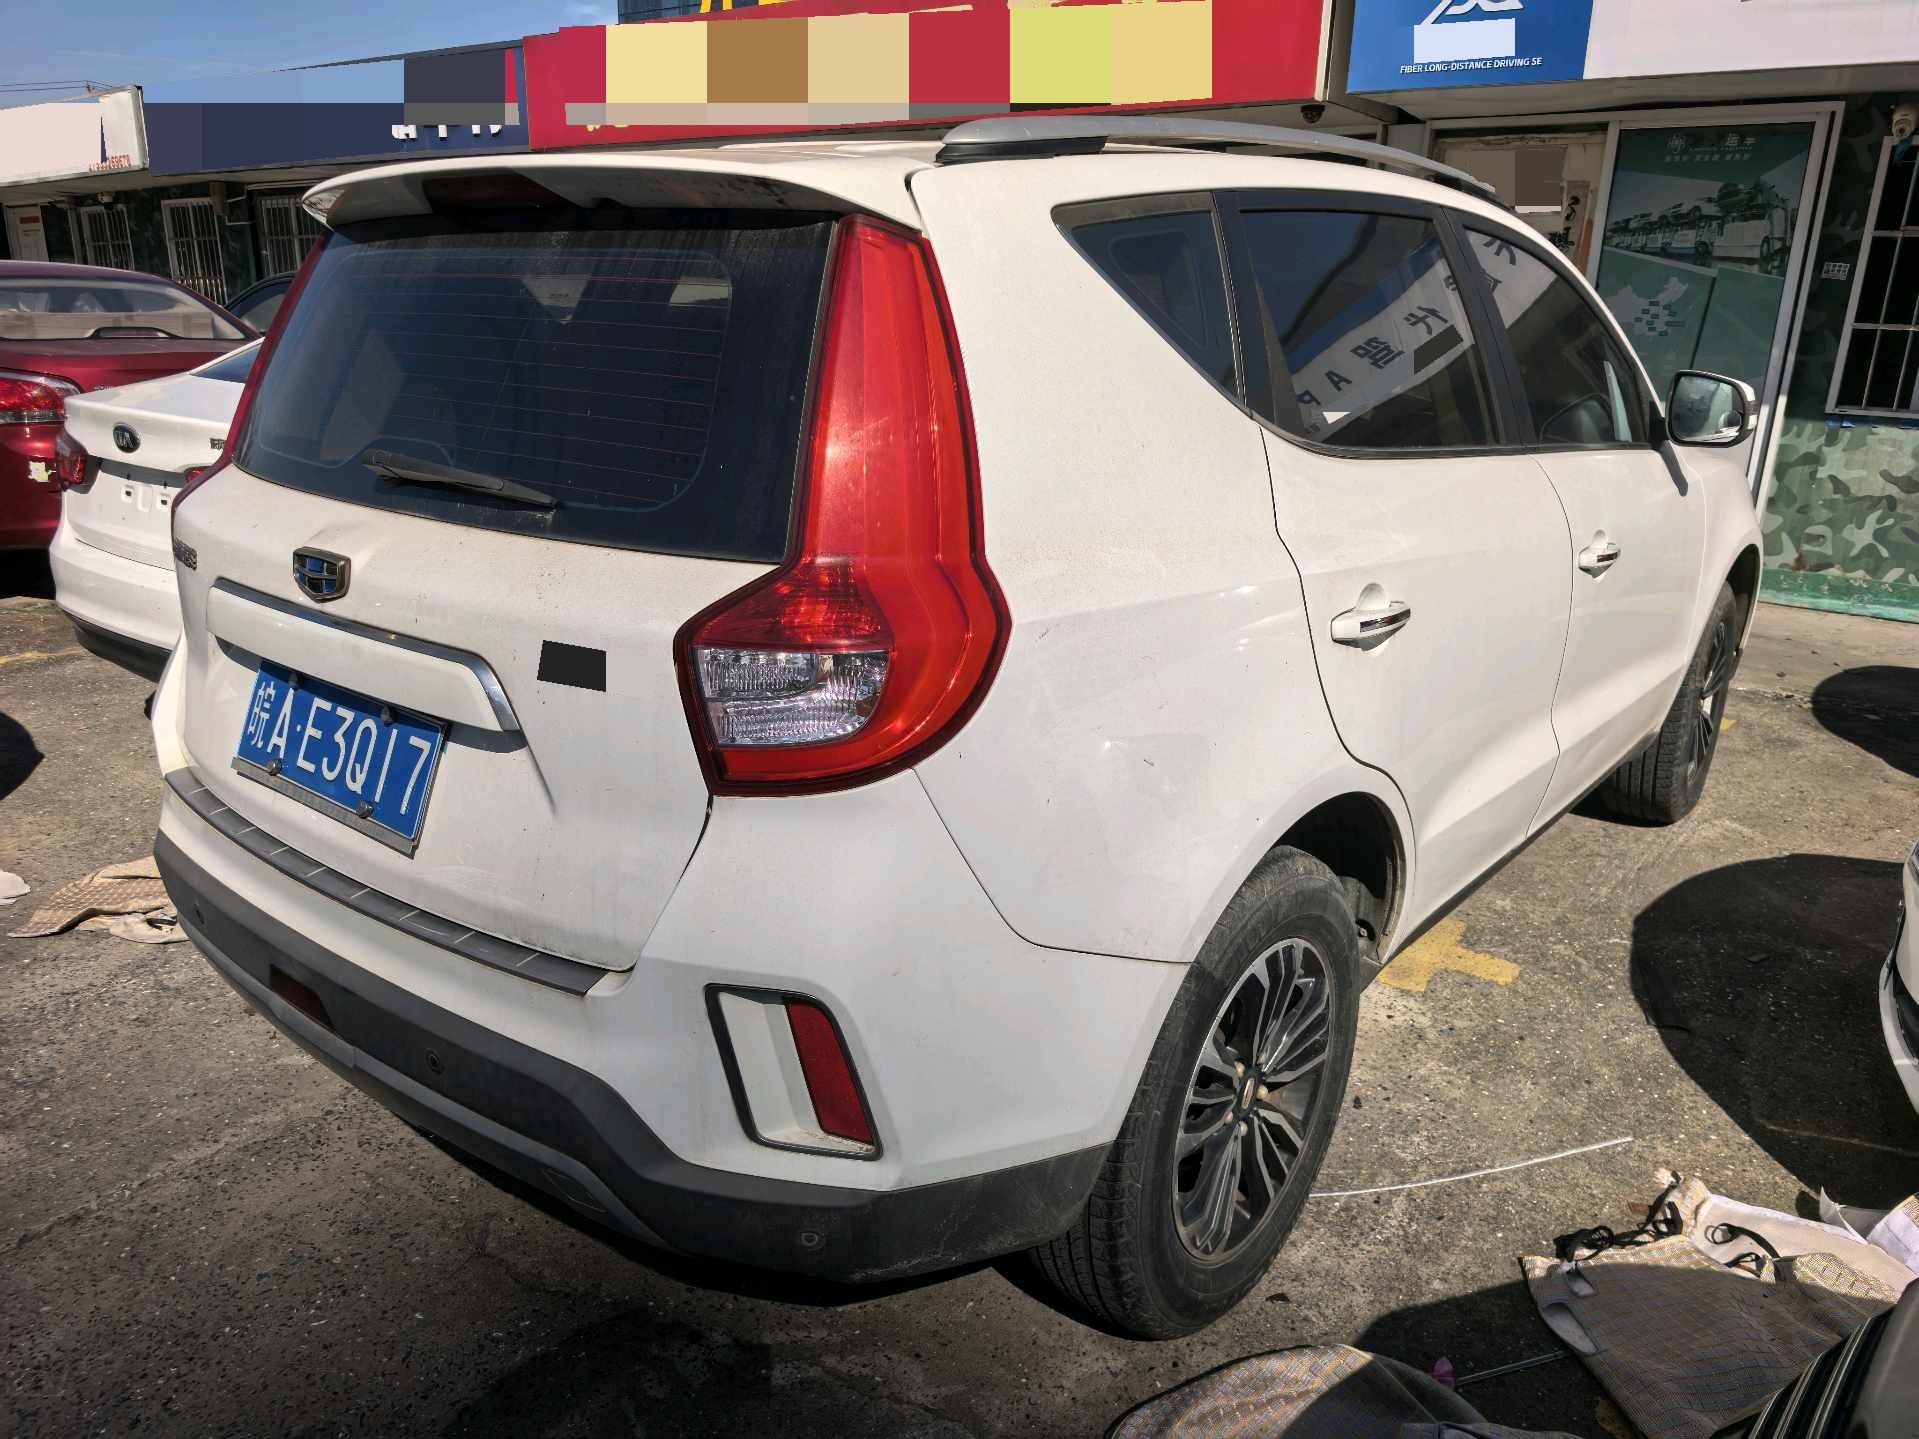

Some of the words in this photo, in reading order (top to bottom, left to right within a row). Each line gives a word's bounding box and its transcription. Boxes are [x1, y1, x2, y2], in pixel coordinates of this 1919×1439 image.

[1400, 64, 1422, 74] FIBER
[1424, 60, 1493, 72] LONG-DISTANCE
[1494, 57, 1531, 69] DRIVING
